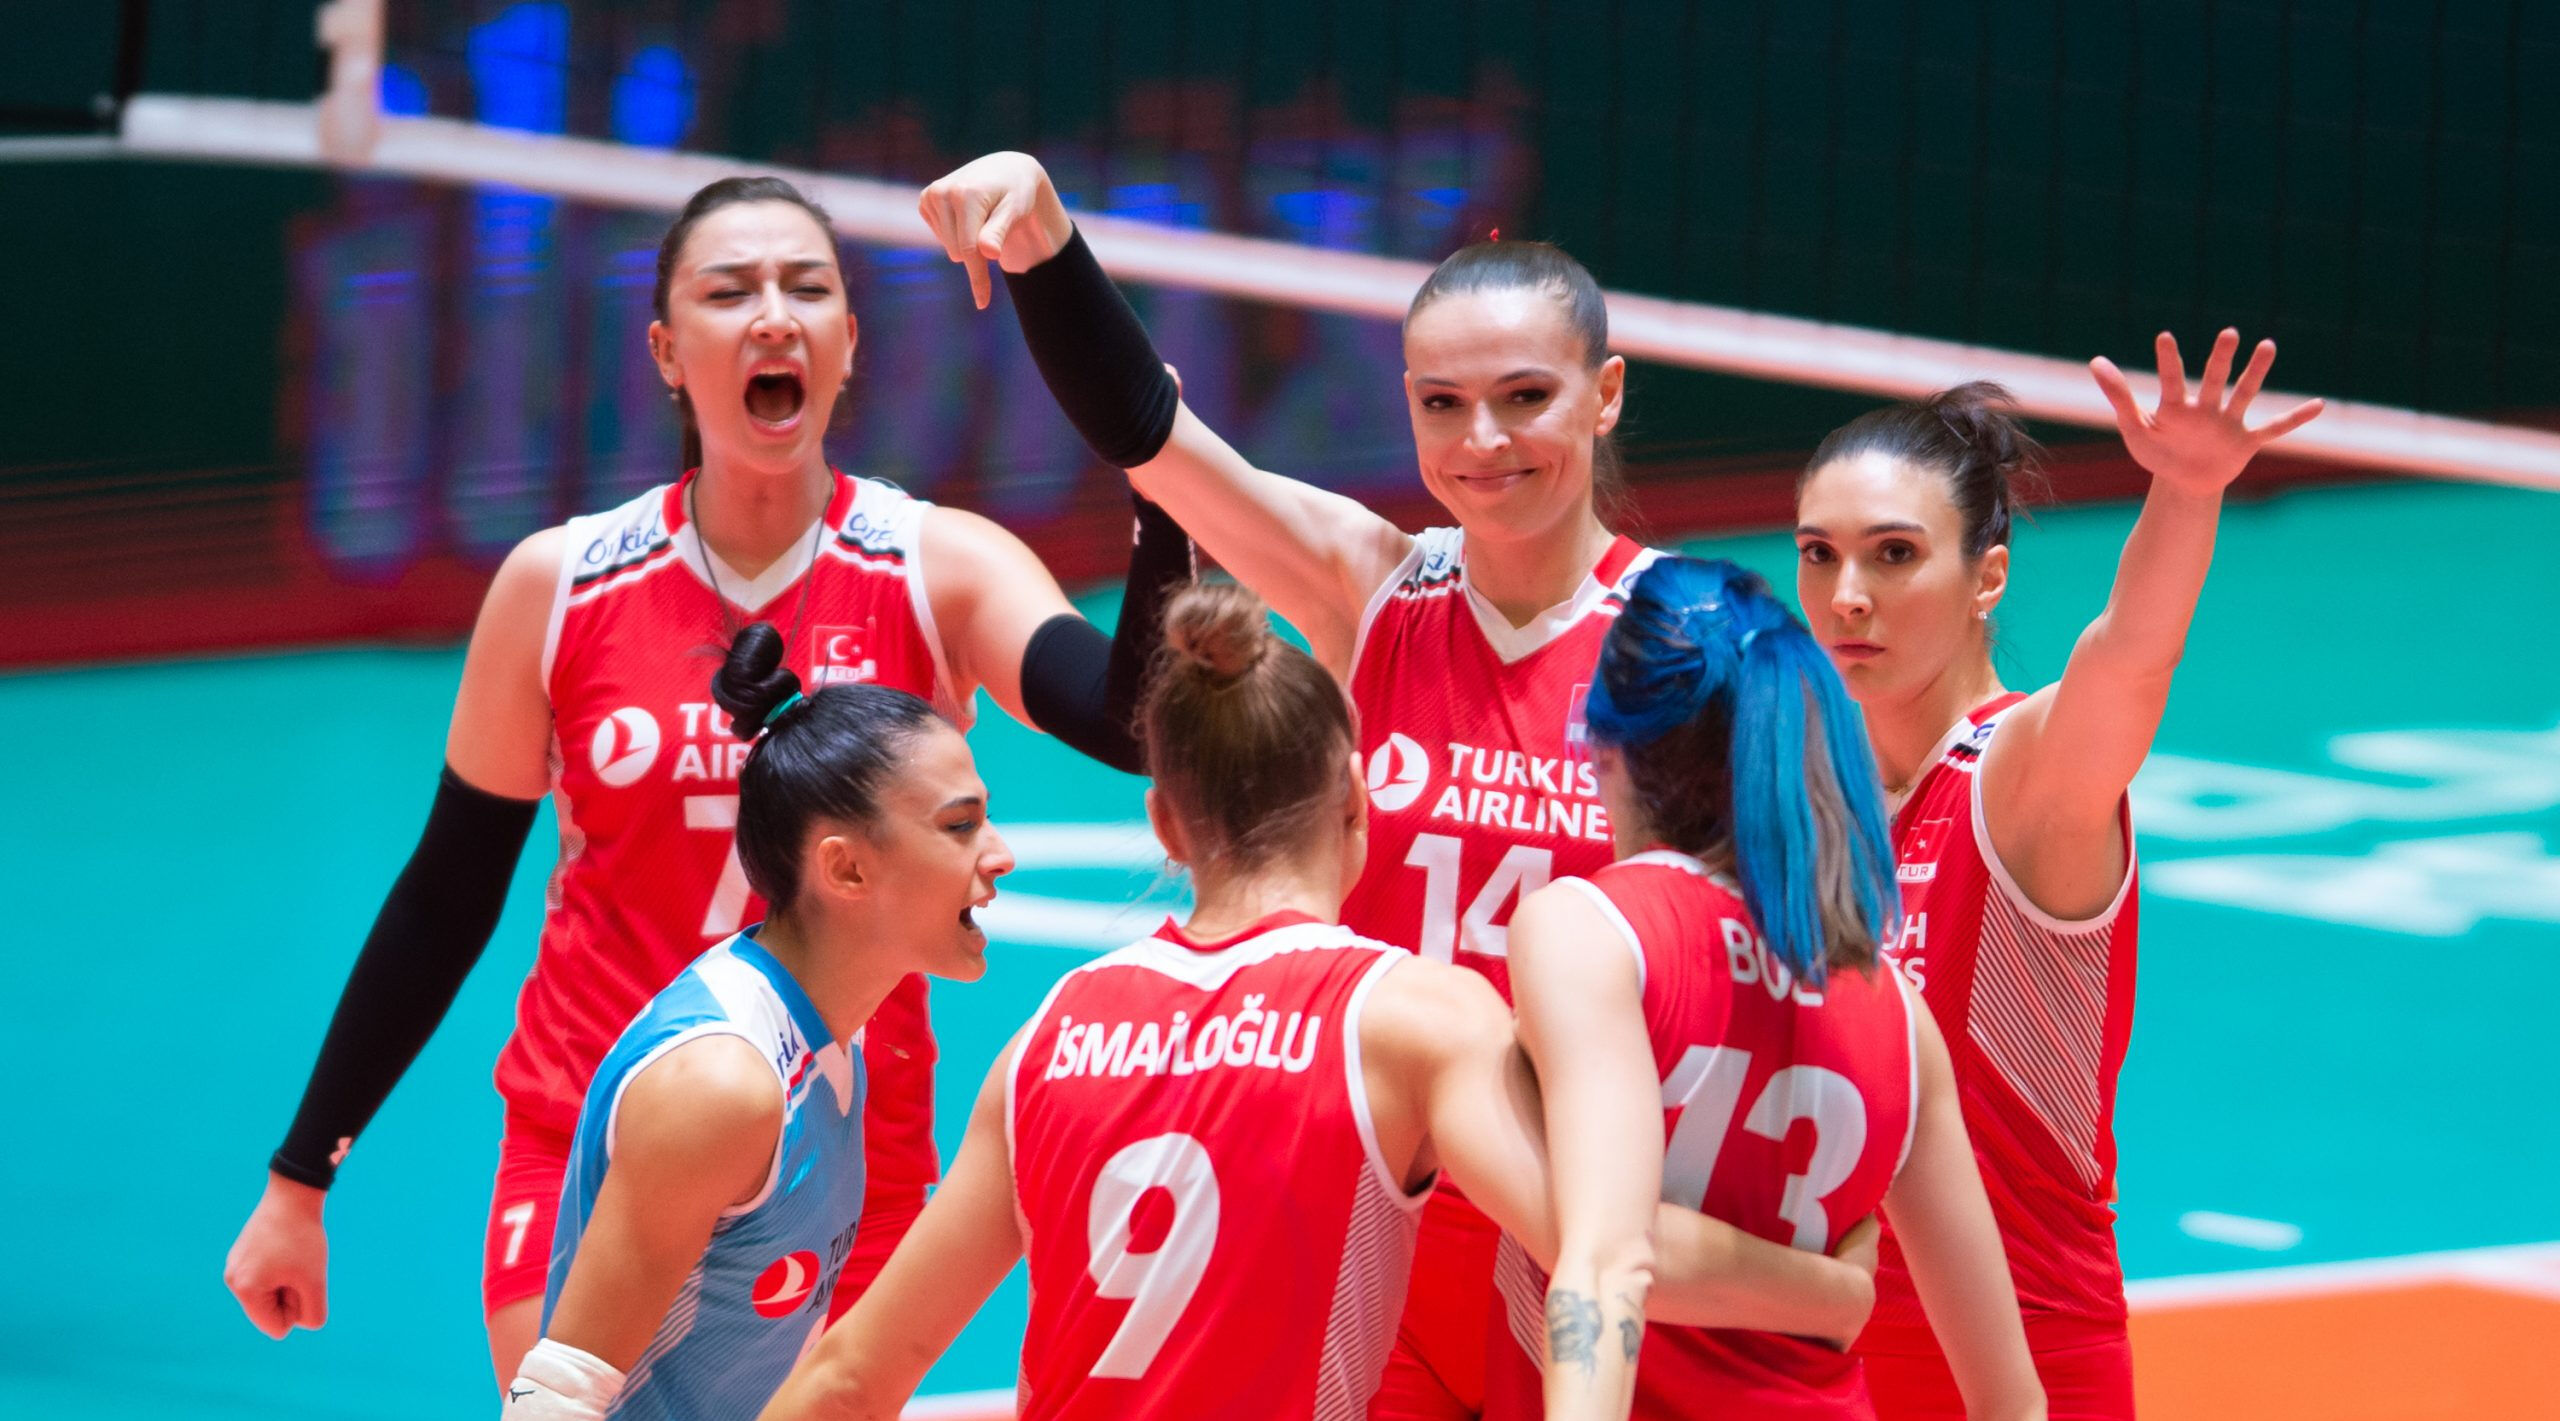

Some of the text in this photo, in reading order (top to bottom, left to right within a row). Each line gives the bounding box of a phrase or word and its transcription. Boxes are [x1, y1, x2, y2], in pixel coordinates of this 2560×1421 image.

[831, 667, 862, 680] TU
[679, 702, 734, 738] TU
[672, 743, 751, 782] AIR
[1447, 742, 1599, 797] TURKIS
[1431, 784, 1616, 841] AIRLINE
[683, 794, 751, 937] 7
[1403, 831, 1554, 965] 14
[1881, 911, 1928, 951] SH
[1044, 993, 1322, 1082] İSMAİLOĞLU
[1660, 1044, 1868, 1255] 13
[502, 1201, 536, 1267] 7
[826, 1220, 861, 1272] TUR
[1087, 1132, 1221, 1381] 9
[805, 1267, 841, 1314] AIR
